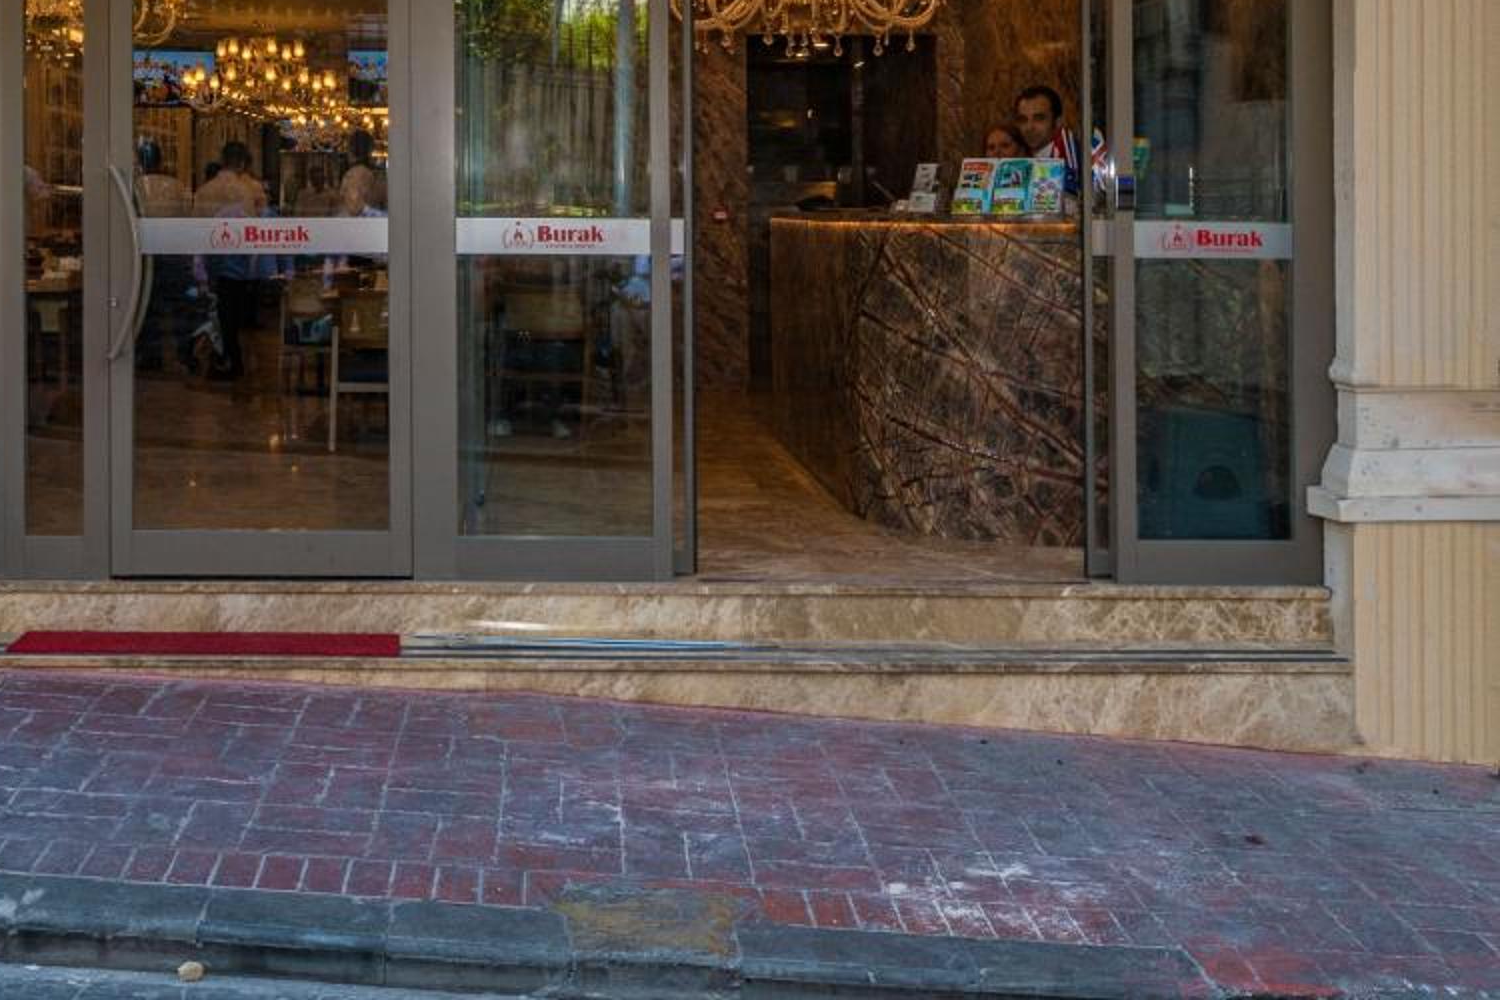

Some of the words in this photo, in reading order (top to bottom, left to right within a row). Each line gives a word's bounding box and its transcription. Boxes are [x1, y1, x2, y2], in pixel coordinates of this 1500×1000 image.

[243, 225, 310, 242] Burak
[537, 225, 604, 242] Burak
[1196, 228, 1263, 247] Burak
